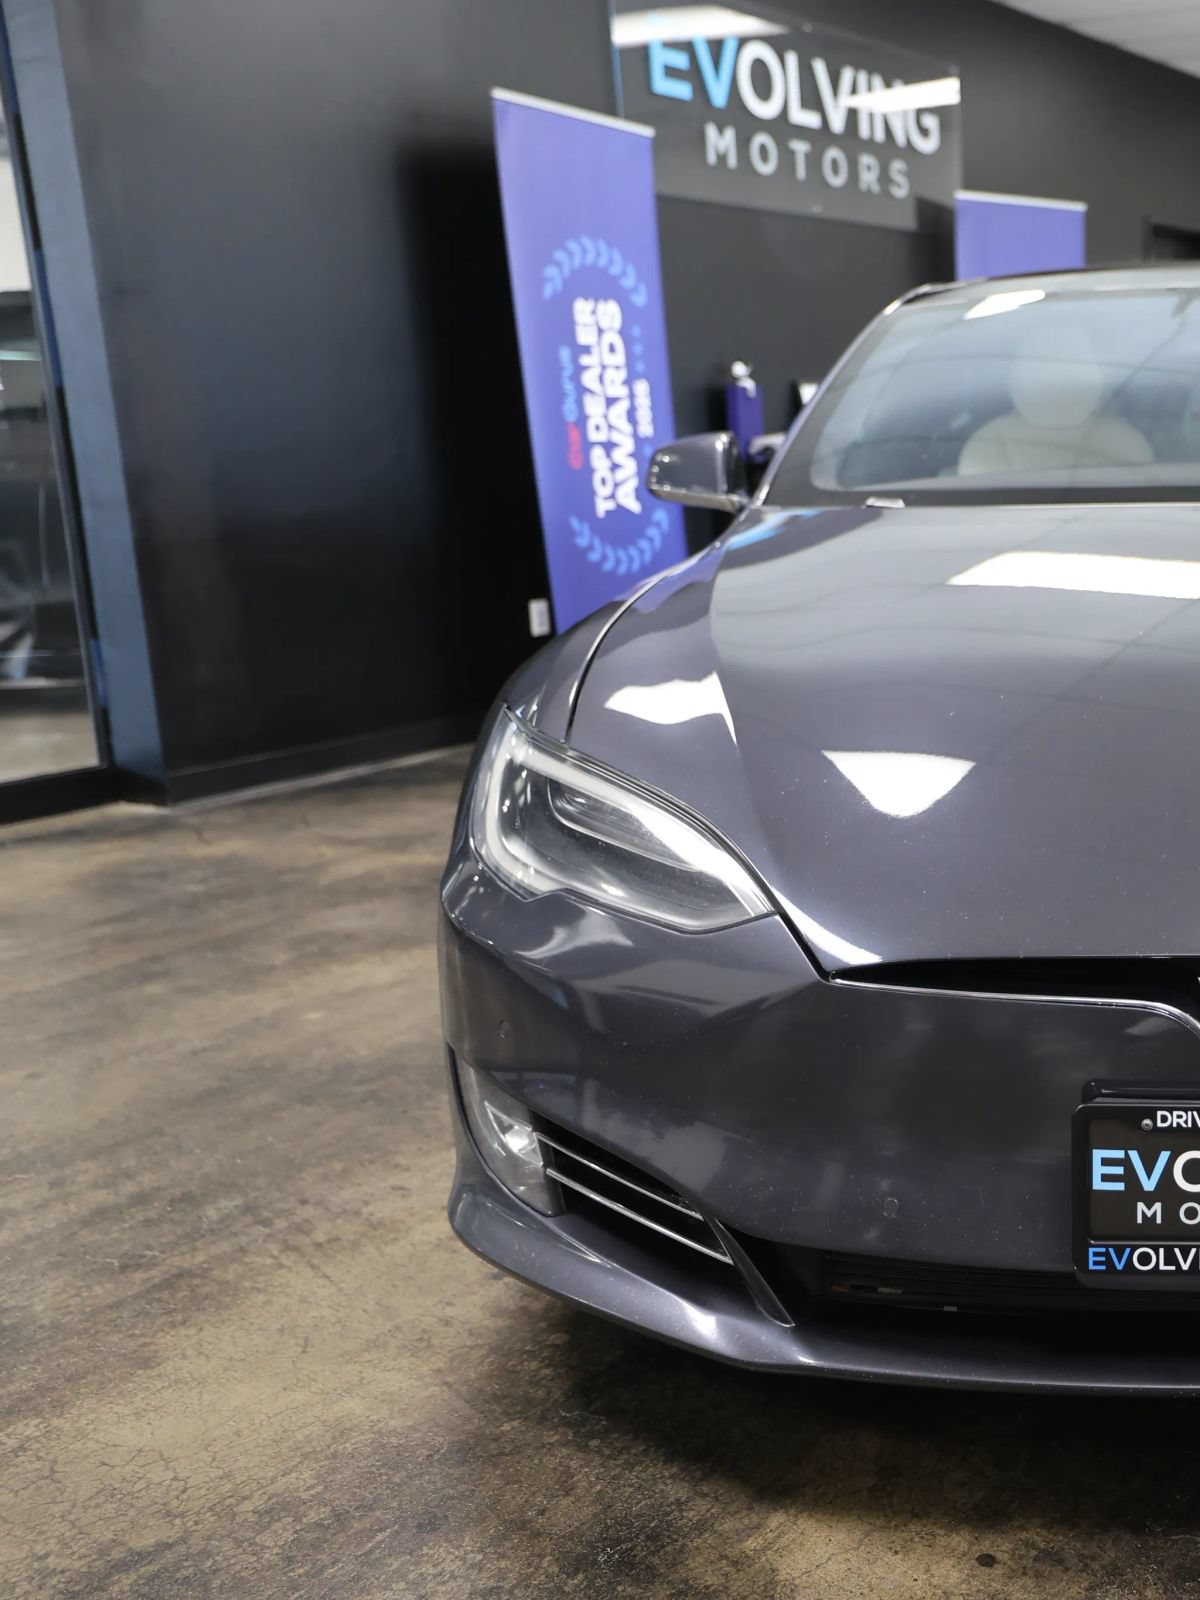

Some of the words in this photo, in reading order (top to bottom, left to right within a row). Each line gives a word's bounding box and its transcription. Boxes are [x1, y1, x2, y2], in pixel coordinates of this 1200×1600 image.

[704, 121, 911, 198] MOTORS
[572, 297, 609, 443] DEALER
[594, 298, 642, 515] AWARDS
[590, 444, 617, 518] TOP
